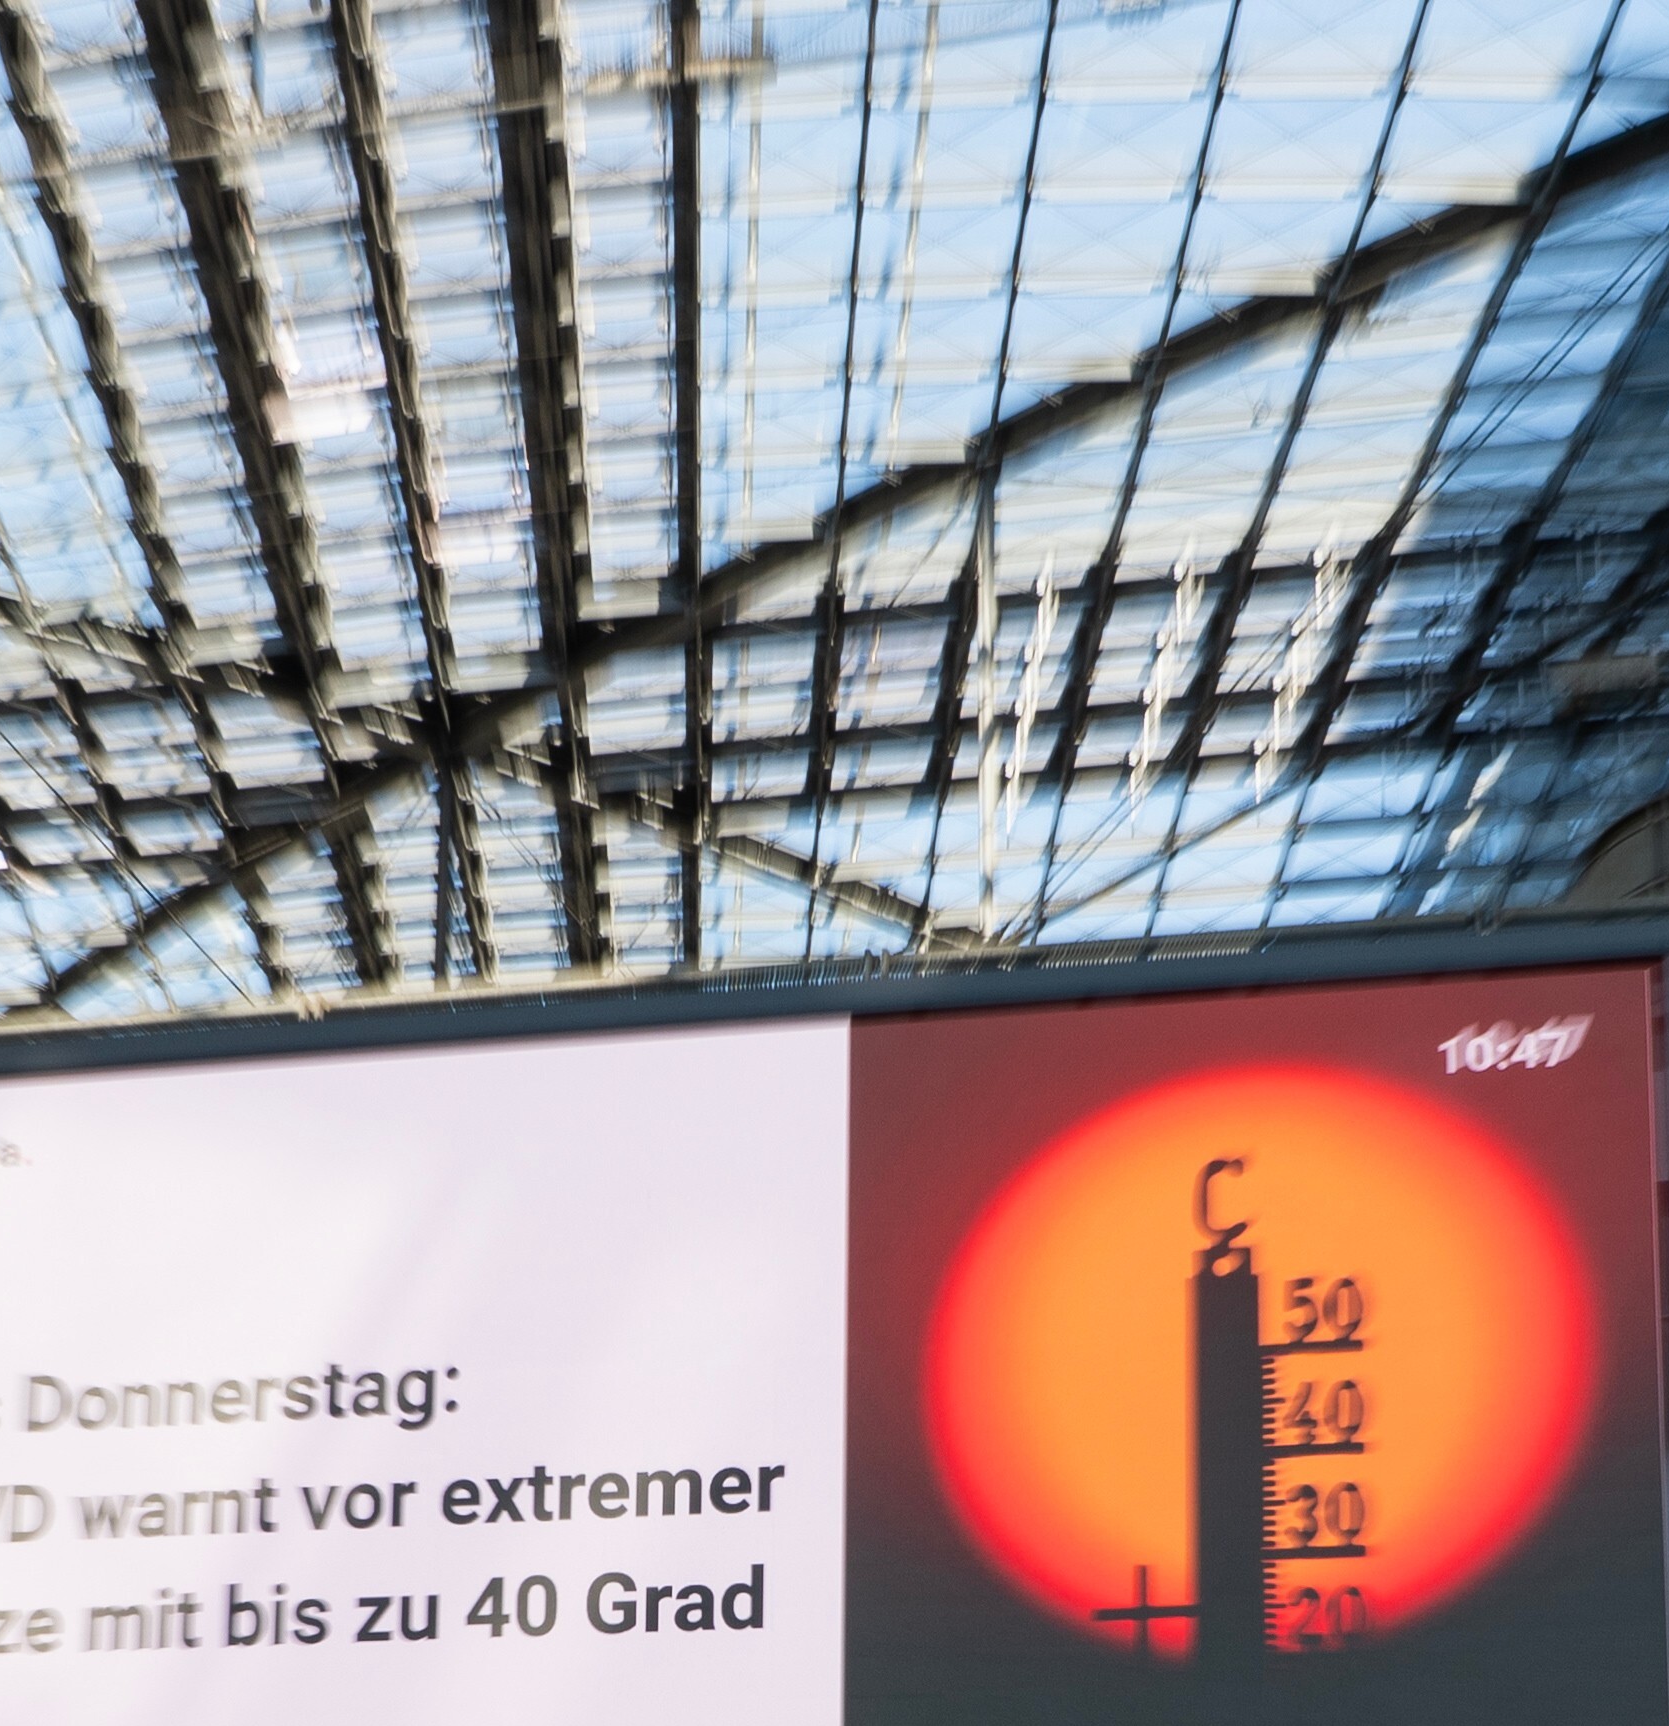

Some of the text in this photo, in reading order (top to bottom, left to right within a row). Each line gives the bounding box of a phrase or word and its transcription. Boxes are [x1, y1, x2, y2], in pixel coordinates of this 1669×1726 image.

[1437, 1020, 1589, 1074] 10:47
[1284, 1278, 1363, 1342] 50
[25, 1364, 460, 1431] Donnerstag:
[1284, 1380, 1363, 1442] 40
[73, 1478, 279, 1540] warnt
[303, 1480, 417, 1530] vor
[441, 1465, 785, 1526] extremer
[1286, 1482, 1365, 1546] 30
[87, 1587, 199, 1651] mit
[227, 1583, 331, 1646] bis
[355, 1594, 439, 1643] zu
[466, 1574, 559, 1638] 40
[585, 1563, 765, 1634] Grad
